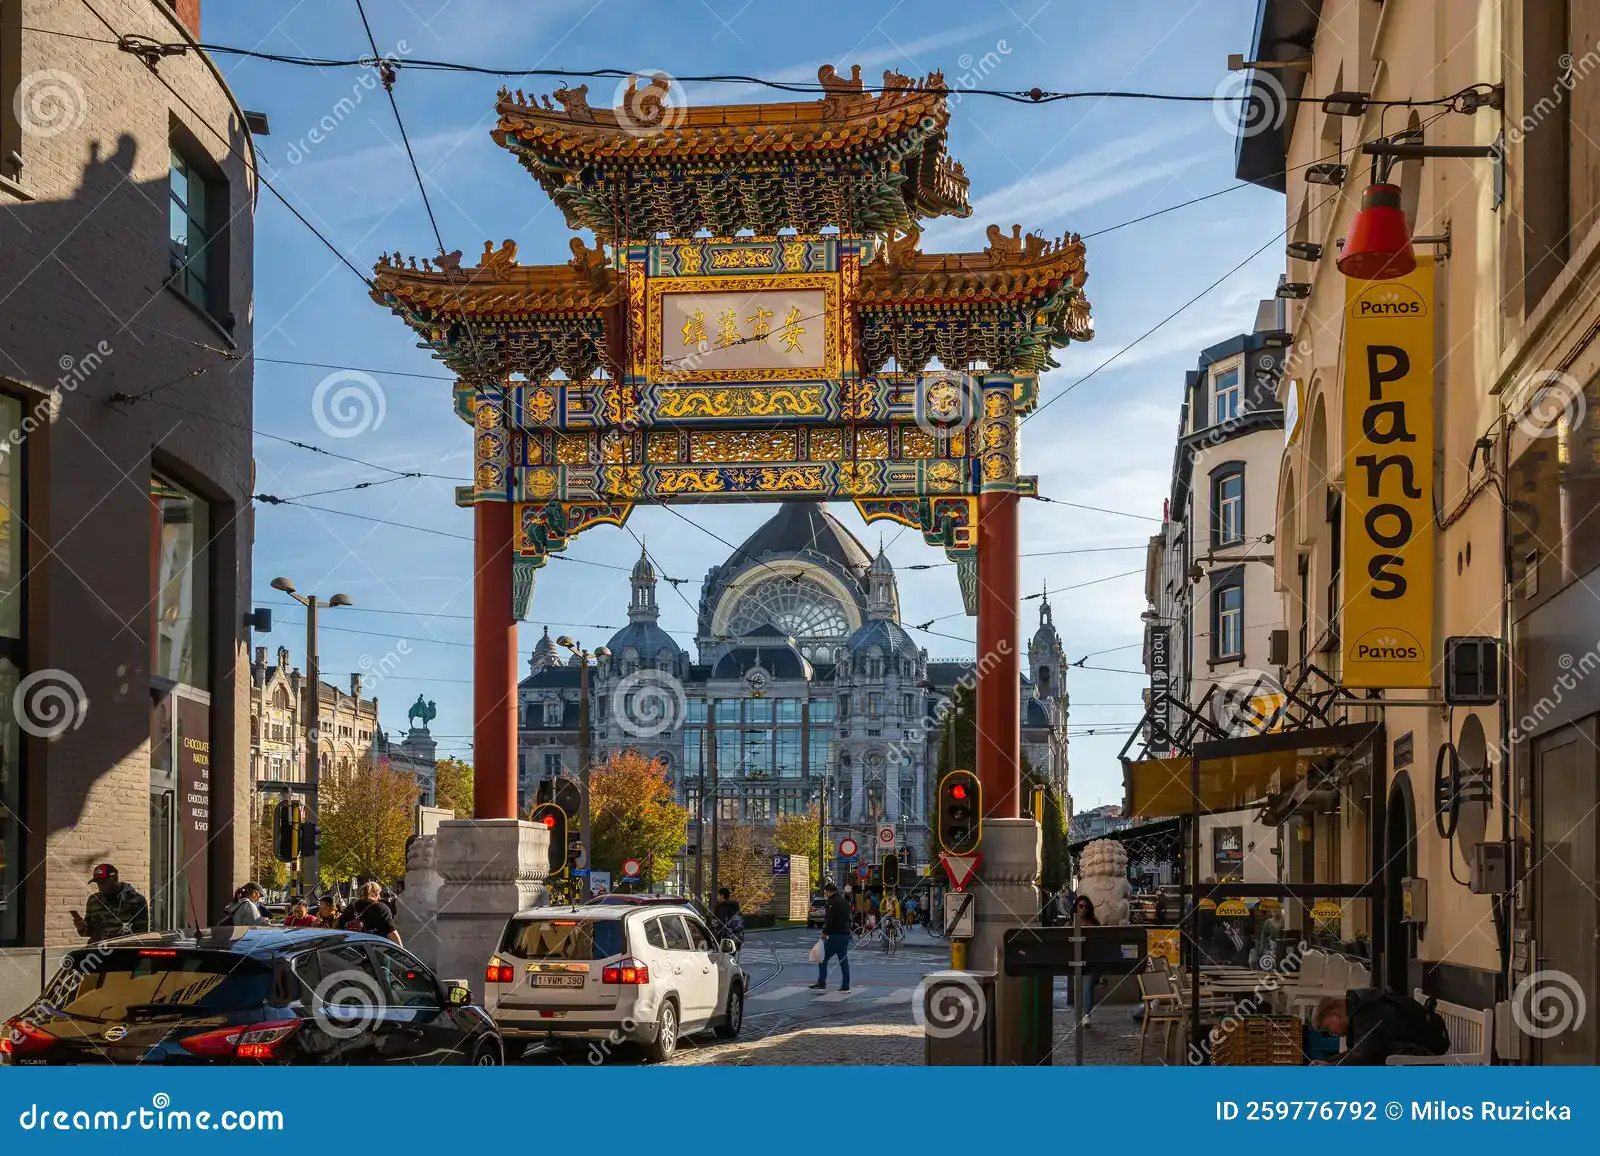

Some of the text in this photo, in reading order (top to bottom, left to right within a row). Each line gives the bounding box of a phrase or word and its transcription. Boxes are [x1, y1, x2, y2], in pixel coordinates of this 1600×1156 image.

[1361, 301, 1420, 315] Panos
[1355, 345, 1422, 600] Panos
[1153, 633, 1167, 667] hotel
[1358, 643, 1418, 659] Panos
[184, 737, 210, 753] CHOCOLATE
